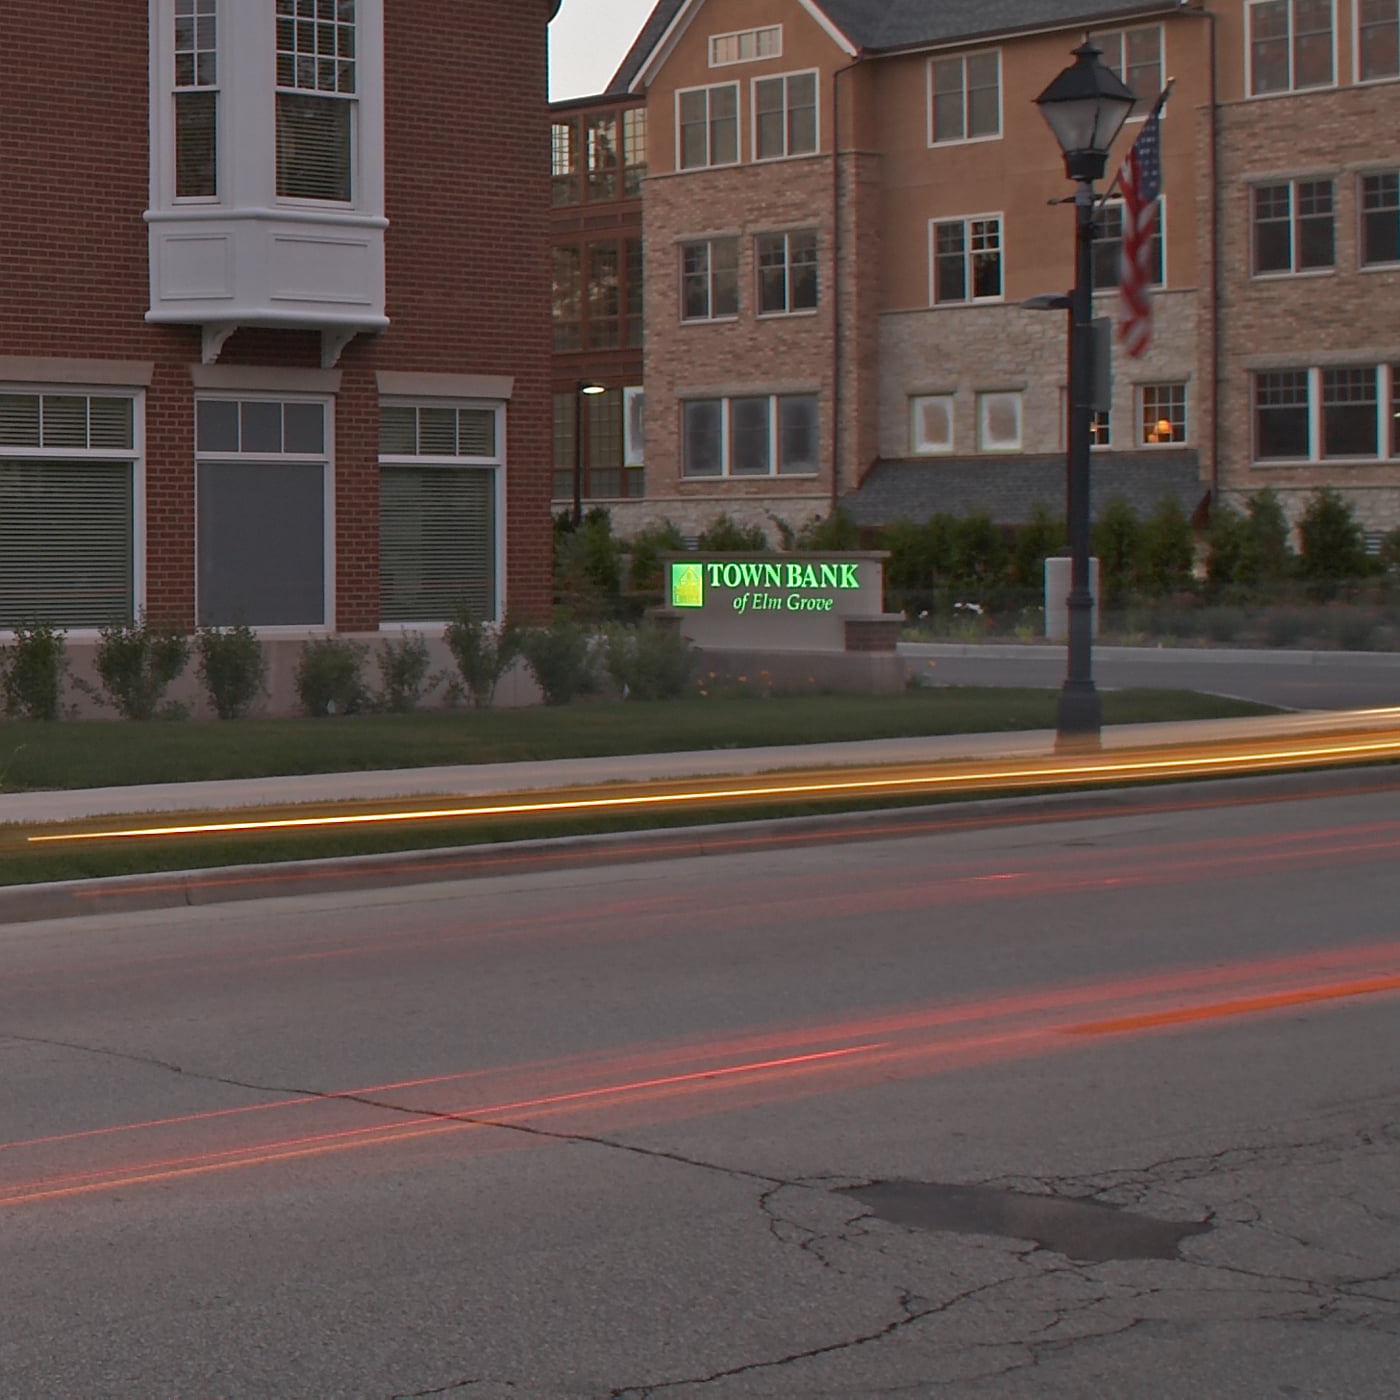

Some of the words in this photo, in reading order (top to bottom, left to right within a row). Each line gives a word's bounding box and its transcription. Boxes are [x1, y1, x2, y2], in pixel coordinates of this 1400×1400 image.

[707, 563, 781, 588] TOWN
[786, 563, 860, 589] BANK
[733, 592, 750, 614] of
[751, 593, 782, 610] Elm
[786, 593, 834, 611] Grove
